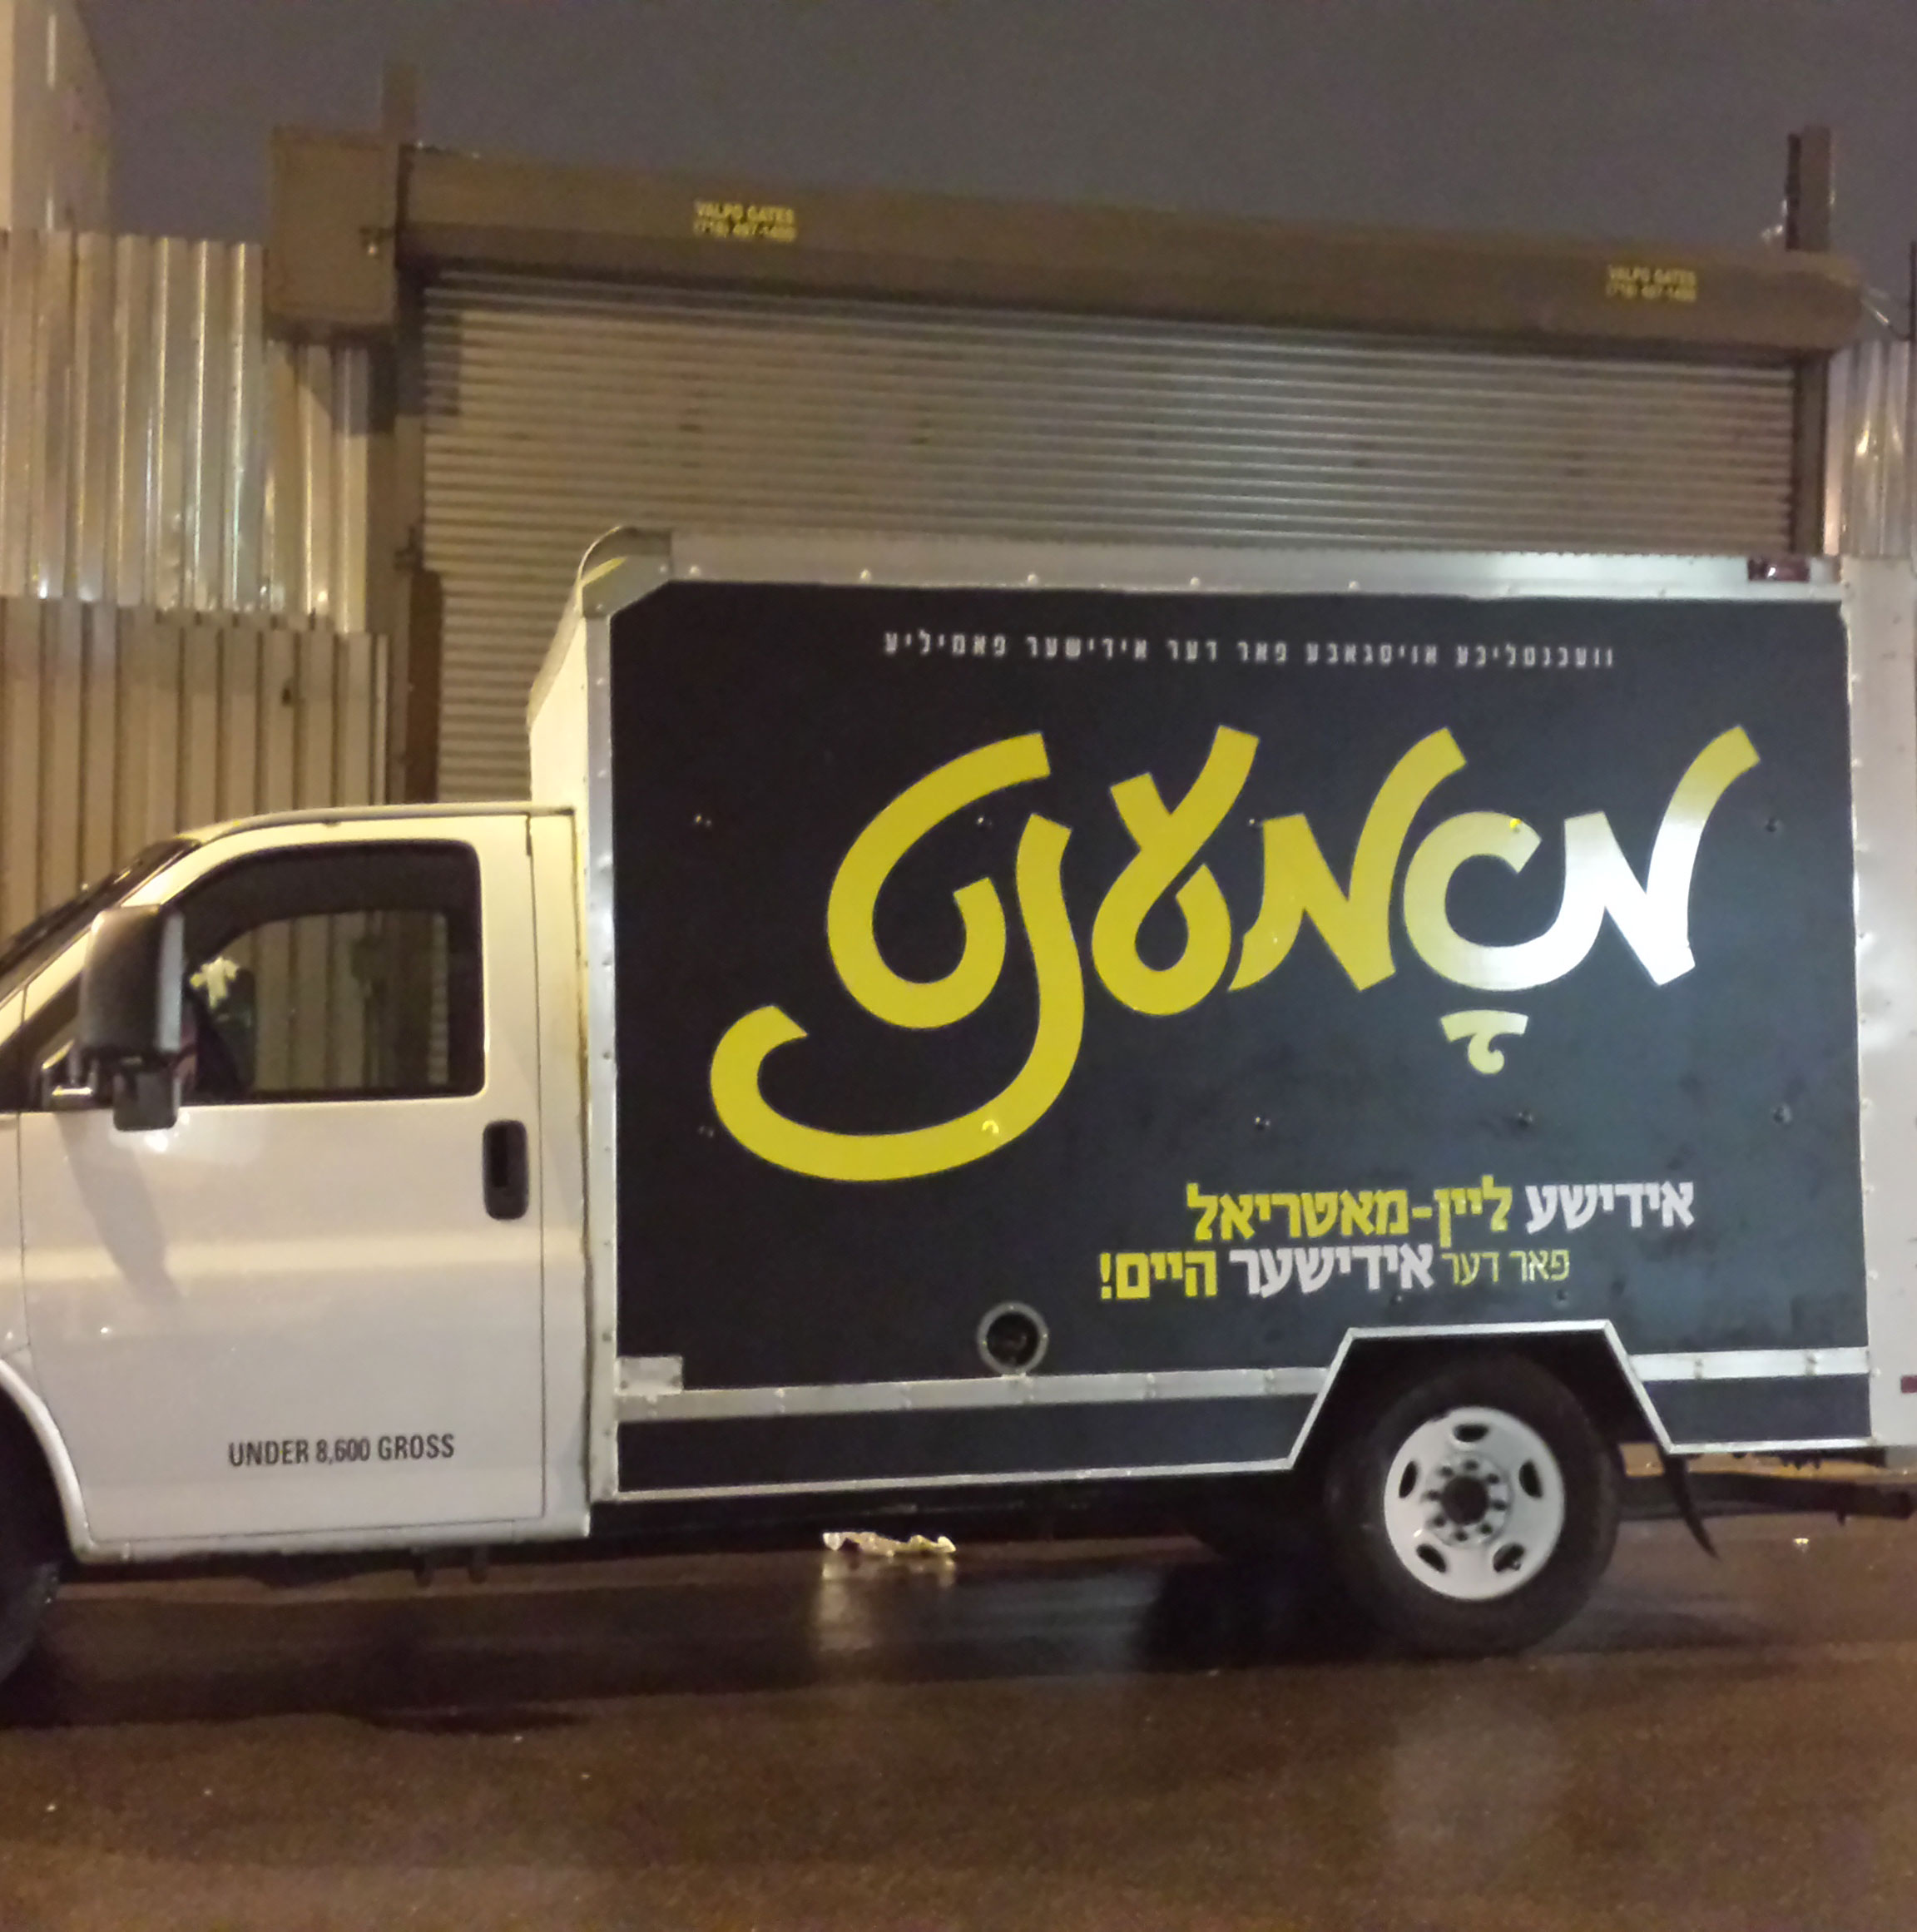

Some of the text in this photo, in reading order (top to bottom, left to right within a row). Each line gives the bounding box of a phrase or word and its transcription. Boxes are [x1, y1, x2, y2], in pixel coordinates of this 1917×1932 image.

[1028, 637, 1147, 658] אידישער
[1169, 640, 1216, 661] דער
[1238, 642, 1286, 662] פאר
[1525, 1181, 1694, 1235] אידישע
[1101, 1243, 1570, 1299] פאר דער אידישער היים!
[229, 1434, 454, 1467] UNDER 8,600 GROSS
